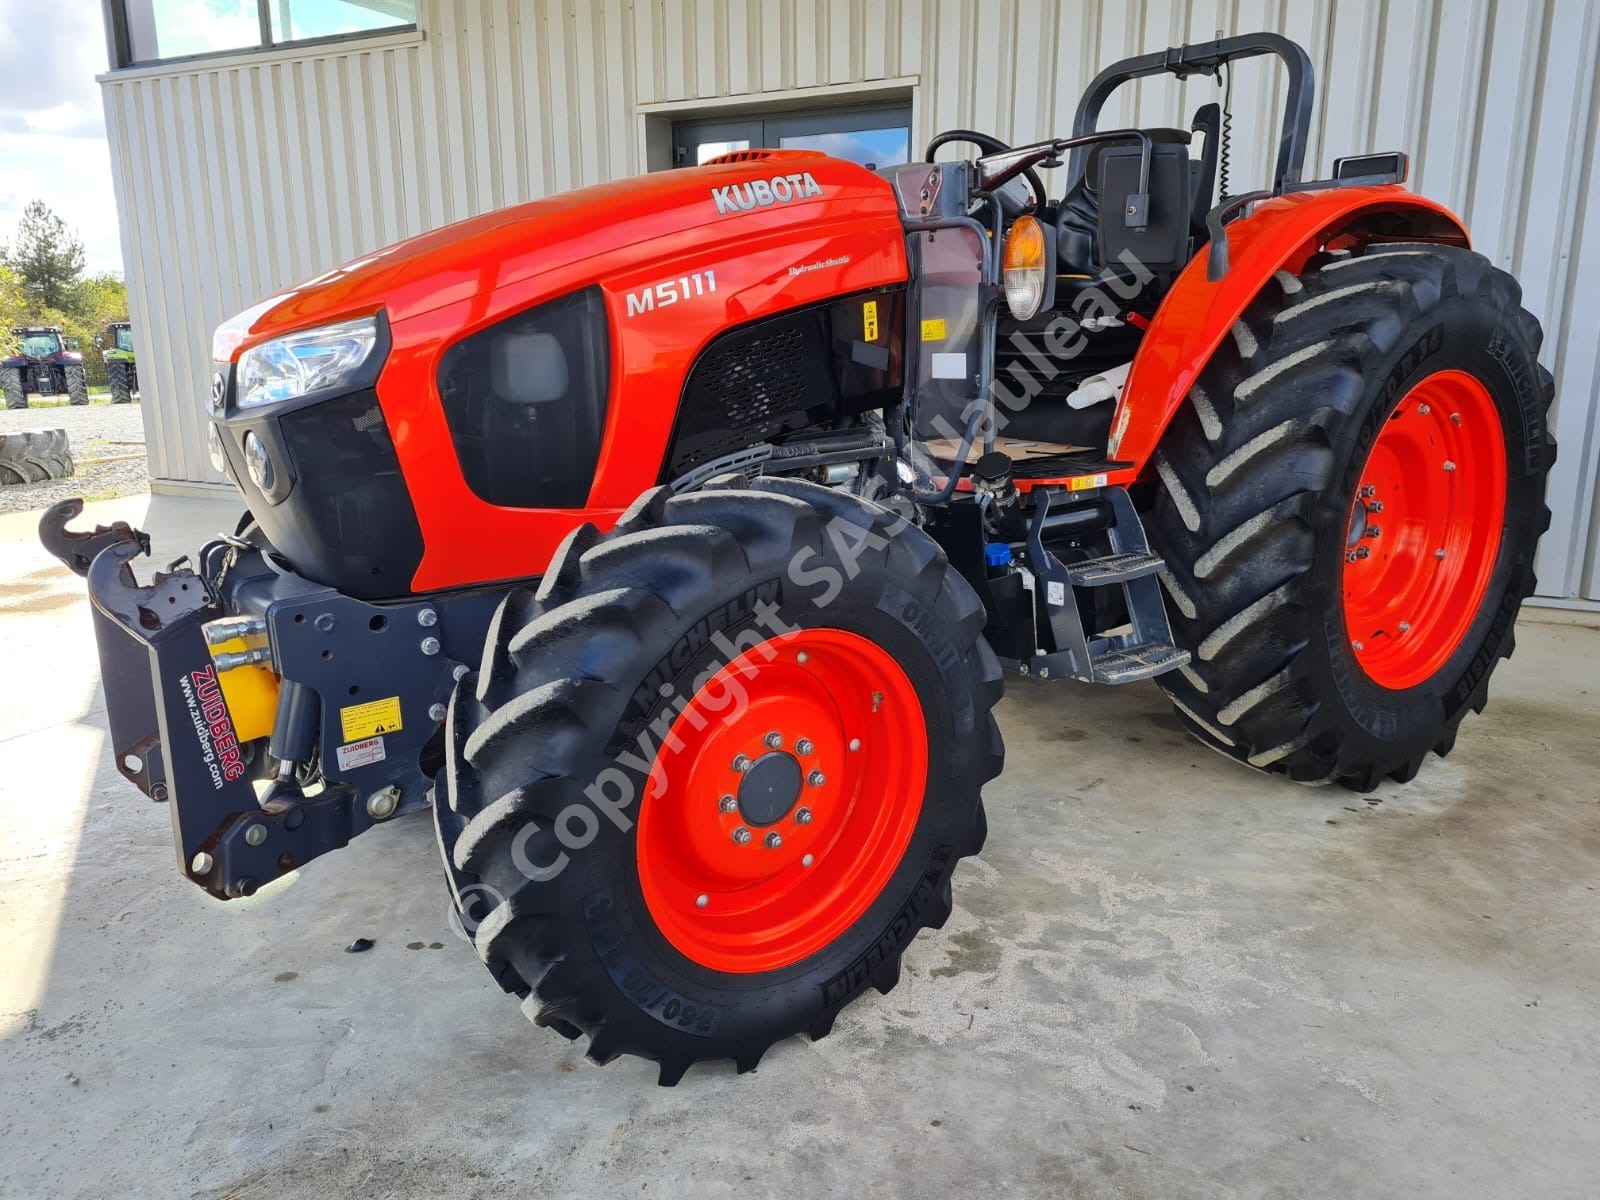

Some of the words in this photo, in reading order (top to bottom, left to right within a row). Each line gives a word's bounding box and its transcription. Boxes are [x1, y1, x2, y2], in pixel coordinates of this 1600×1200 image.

[711, 172, 824, 215] KUBOTA
[626, 270, 717, 318] M5111
[788, 261, 825, 276] Hydraulic
[632, 577, 783, 714] MICHELIN
[178, 674, 224, 791] www.zuidberg.com
[191, 664, 245, 782] ZUIDBERG
[342, 739, 379, 754] ZUIDBERG
[826, 873, 933, 1006] MICHELIN
